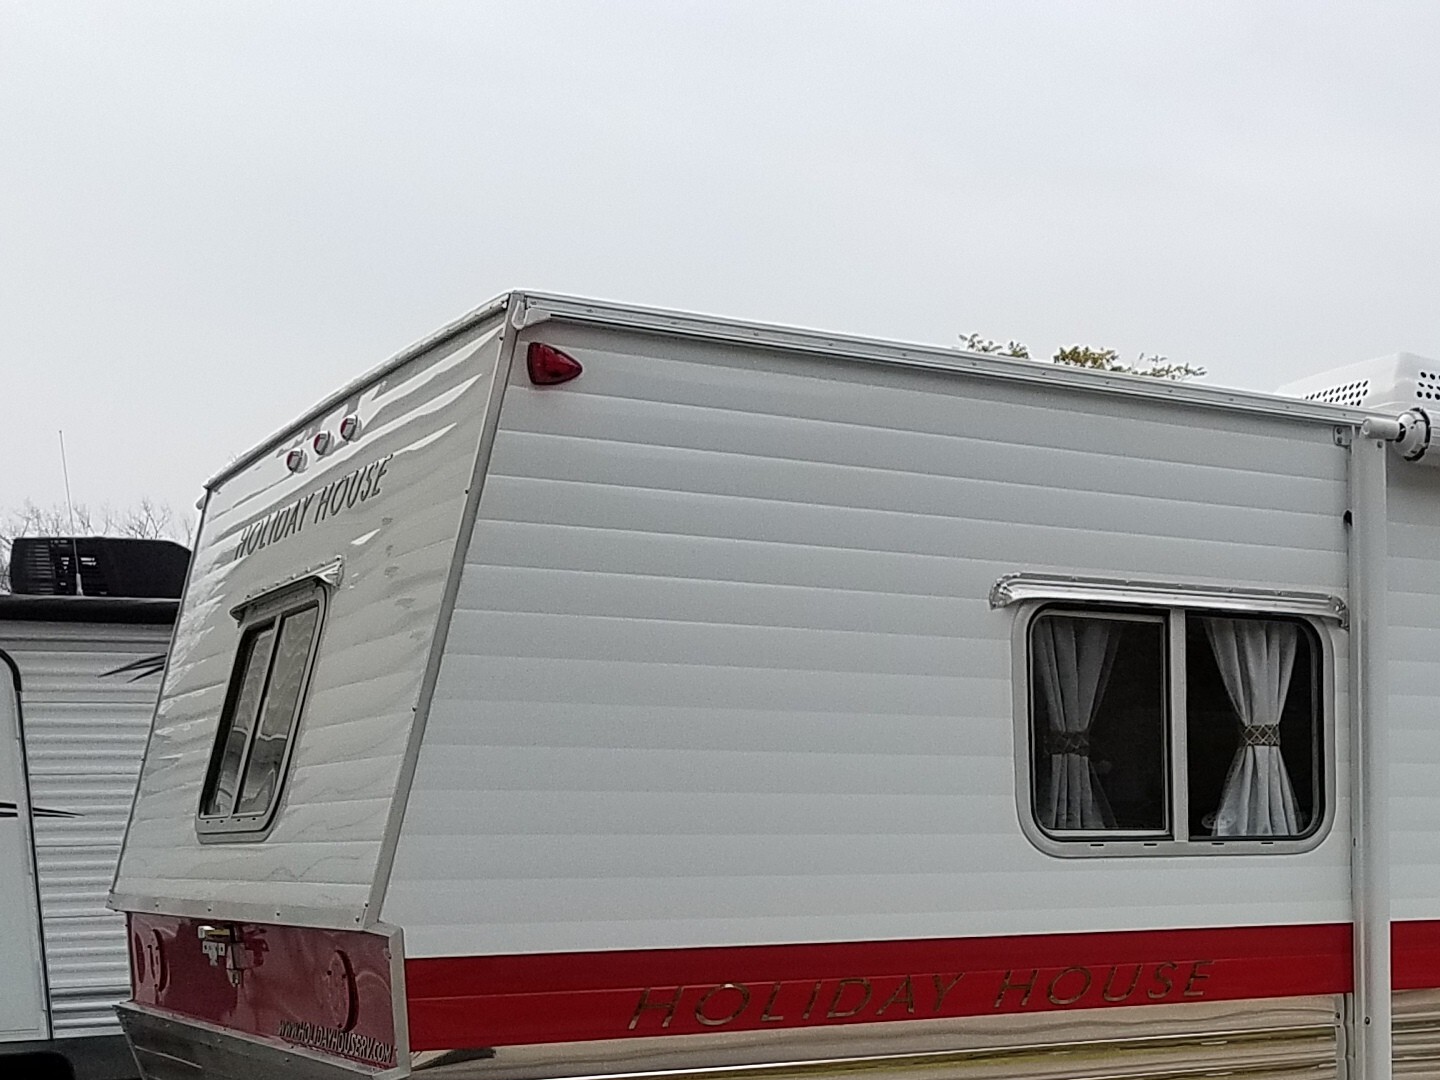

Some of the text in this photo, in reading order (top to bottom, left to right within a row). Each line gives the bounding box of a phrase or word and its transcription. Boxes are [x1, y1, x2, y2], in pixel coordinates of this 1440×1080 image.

[234, 454, 393, 560] HOLIDAY HOUSE
[628, 960, 1215, 1030] HOLIDAY HOUSE
